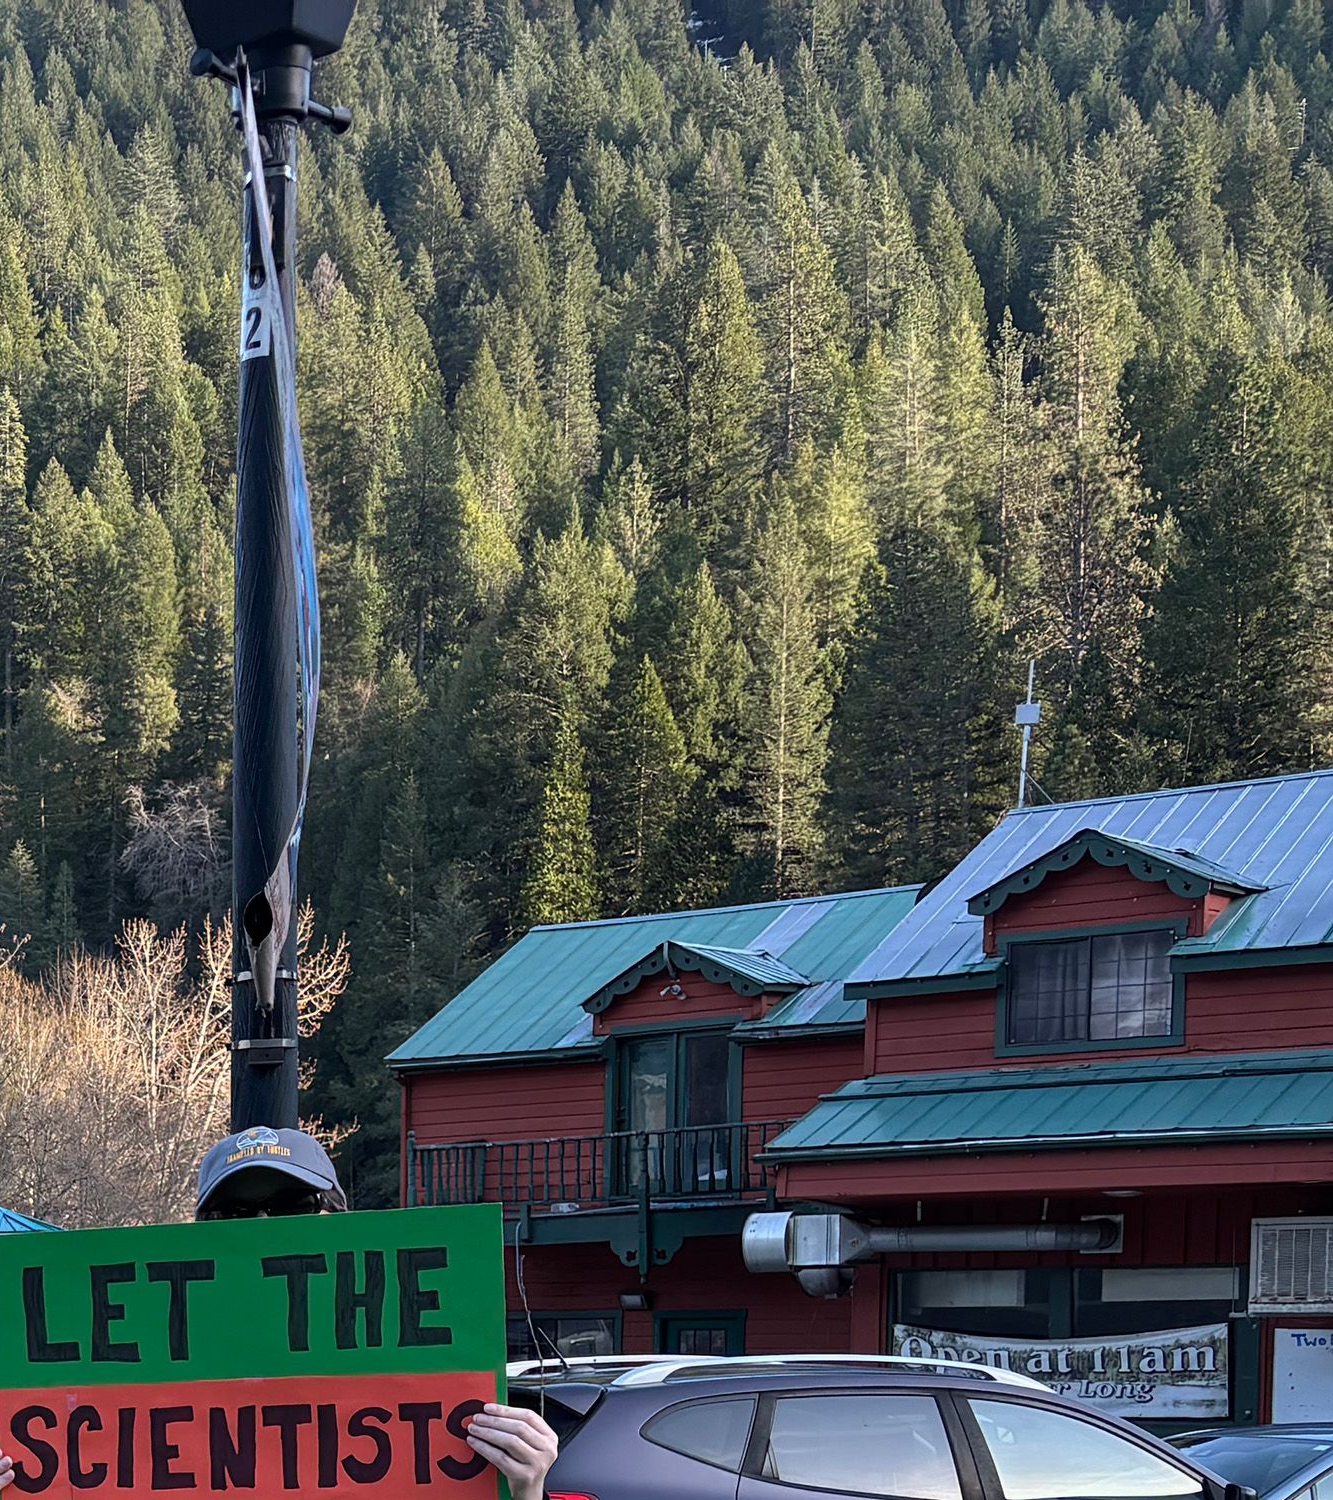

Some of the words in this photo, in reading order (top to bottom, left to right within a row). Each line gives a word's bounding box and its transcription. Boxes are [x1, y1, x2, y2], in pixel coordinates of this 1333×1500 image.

[22, 1258, 216, 1363] LET
[261, 1246, 453, 1351] THE
[900, 1336, 1012, 1374] Open
[1026, 1346, 1073, 1373] at
[1093, 1346, 1217, 1373] 11am
[1078, 1380, 1157, 1403] Long
[9, 1398, 487, 1495] SCIENTISTS
